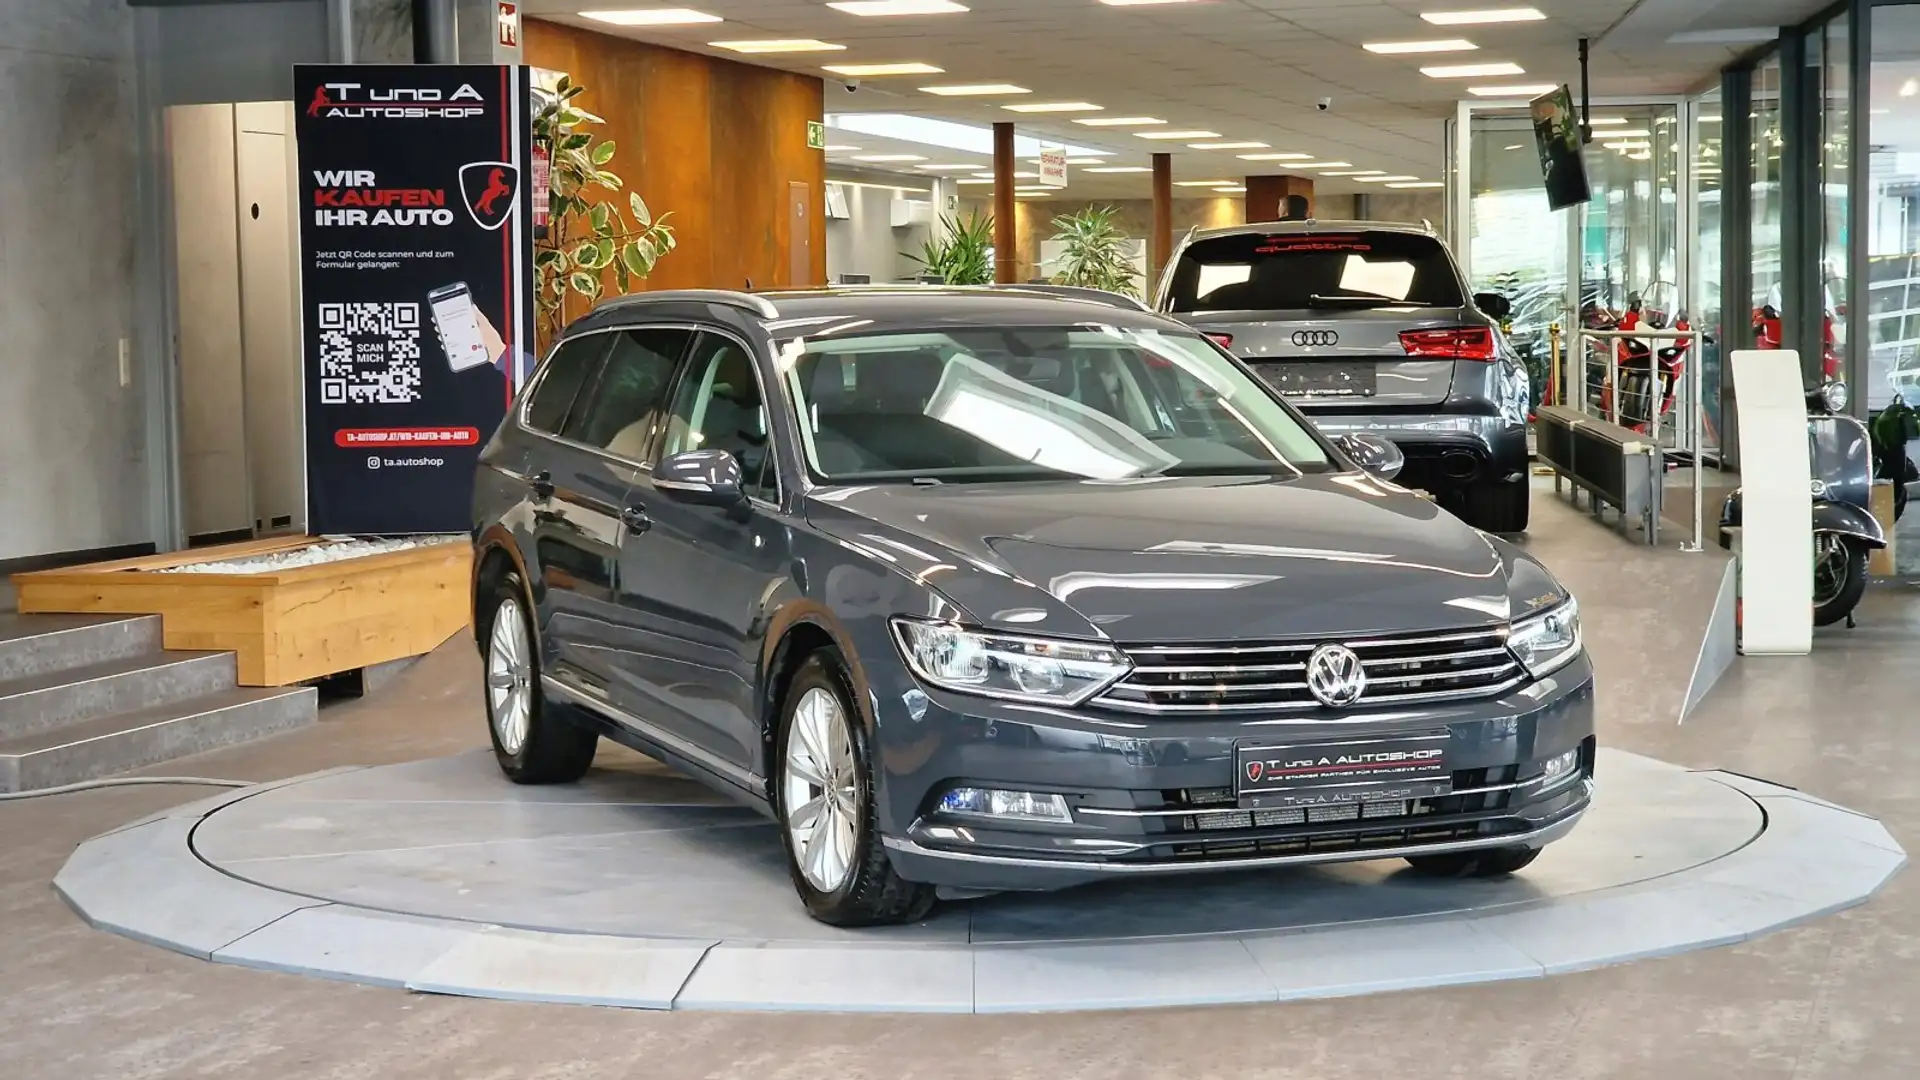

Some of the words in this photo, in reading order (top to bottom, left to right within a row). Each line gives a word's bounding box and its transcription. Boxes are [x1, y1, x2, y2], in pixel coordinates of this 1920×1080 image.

[325, 83, 361, 100] T
[449, 83, 484, 101] A
[326, 107, 484, 118] AUTOSHOP
[313, 170, 375, 187] WIR
[314, 189, 444, 207] KAUFEN
[315, 209, 370, 226] IHR
[371, 209, 454, 226] AUTO
[1255, 243, 1372, 253] quattro
[338, 251, 352, 259] QR
[353, 250, 376, 258] Code
[416, 250, 433, 258] und
[357, 261, 400, 270] gelangen:
[357, 344, 384, 352] SCAN
[357, 354, 384, 363] MICH
[384, 457, 444, 467] ta.autoshop
[1266, 760, 1280, 768] T
[1318, 757, 1330, 765] A
[1336, 749, 1443, 764] AUTOSHOP
[1332, 789, 1411, 802] AUTOSHOP
